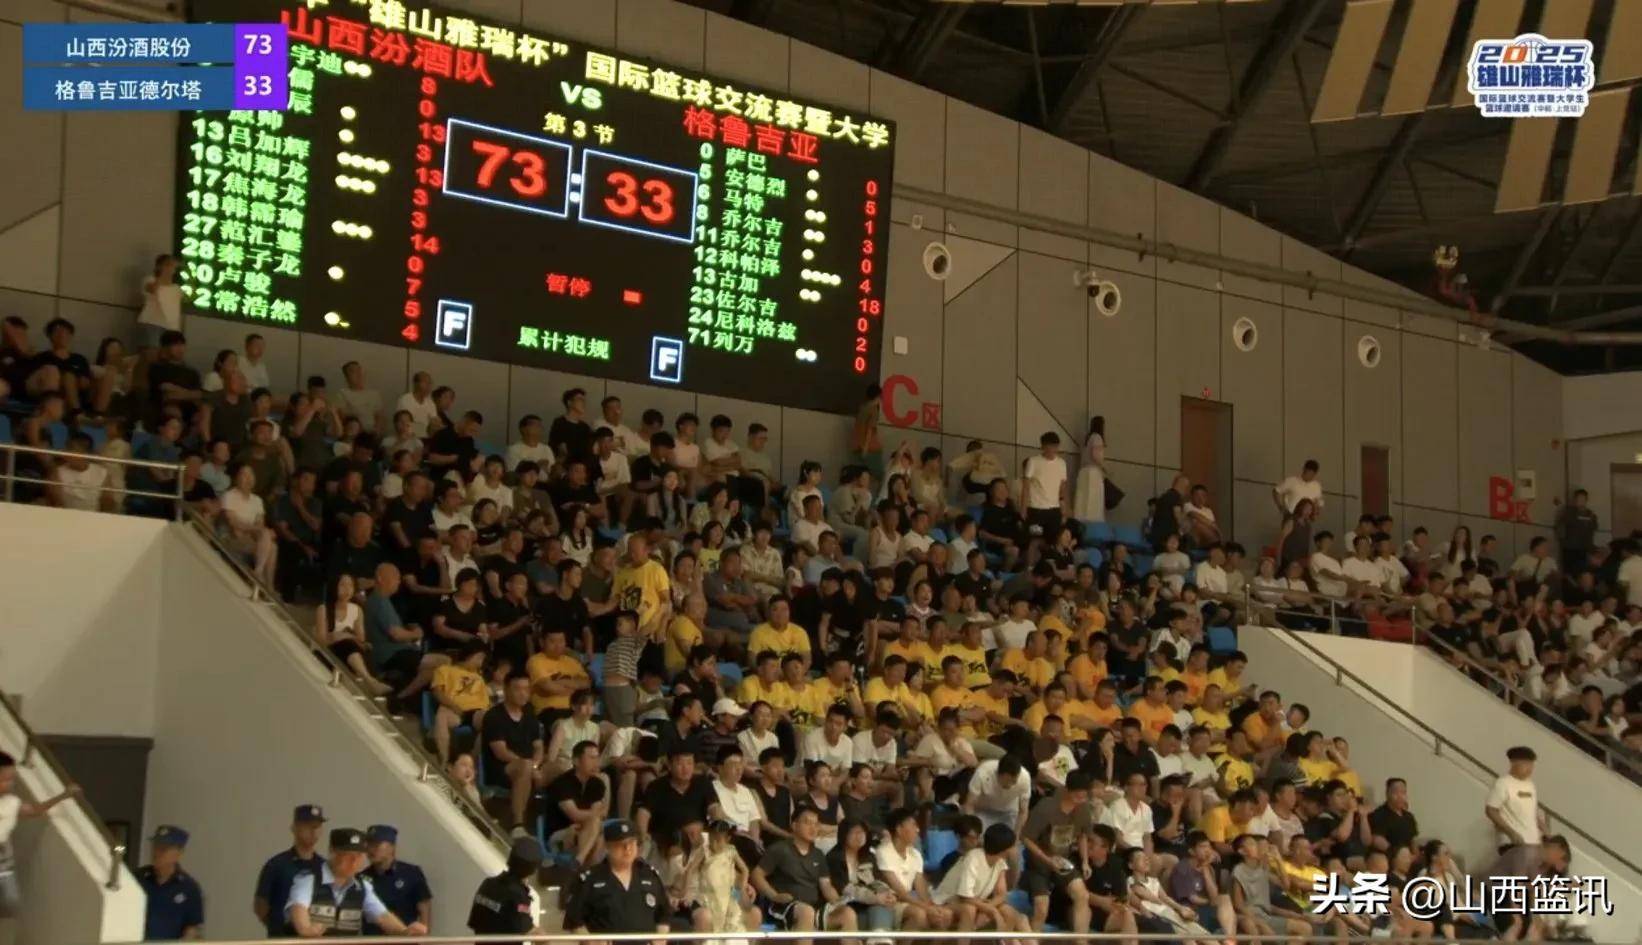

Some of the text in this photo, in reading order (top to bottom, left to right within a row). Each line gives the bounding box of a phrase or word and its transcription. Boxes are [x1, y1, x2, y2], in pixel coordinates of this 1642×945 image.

[420, 76, 437, 96] 8
[561, 81, 602, 109] VS
[419, 99, 435, 118] 0
[585, 51, 889, 148] 国际篮球交流赛暨大学
[192, 118, 224, 141] 13
[418, 122, 446, 143] 13
[683, 105, 818, 163] 格鲁吉亚
[190, 142, 222, 165] 16
[416, 144, 432, 163] 3
[700, 143, 713, 159] 0
[189, 166, 221, 188] 17
[415, 166, 443, 187] 13
[472, 139, 547, 197] 73
[604, 171, 674, 223] 33
[700, 163, 786, 198] 5 安德烈
[413, 188, 428, 207] 3
[698, 184, 764, 213] 6 马特
[866, 180, 877, 197] 0
[187, 190, 219, 212] 18
[864, 200, 876, 216] 5
[183, 213, 217, 235] 27
[411, 210, 427, 229] 3
[697, 204, 783, 238] 8 乔尔吉
[864, 220, 874, 237] 1
[181, 237, 215, 260] 28
[410, 233, 439, 255] 14
[696, 225, 781, 258] 11 乔尔吉
[862, 239, 873, 255] 3
[407, 255, 424, 274] 0
[694, 246, 718, 265] 12
[861, 258, 872, 274] 0
[406, 277, 421, 296] 7
[547, 273, 591, 298] 暂停
[692, 266, 758, 293] 13 古加
[859, 279, 871, 294] 4
[690, 286, 715, 305] 23
[404, 300, 420, 319] 5
[688, 306, 713, 326] 24
[859, 299, 880, 316] 18
[401, 323, 418, 342] 4
[443, 310, 467, 338] F
[857, 317, 868, 332] 0
[517, 326, 610, 360] 累计犯规
[688, 327, 755, 355] 71 列万
[855, 337, 867, 353] 2
[658, 346, 679, 372] F
[854, 356, 866, 372] 0
